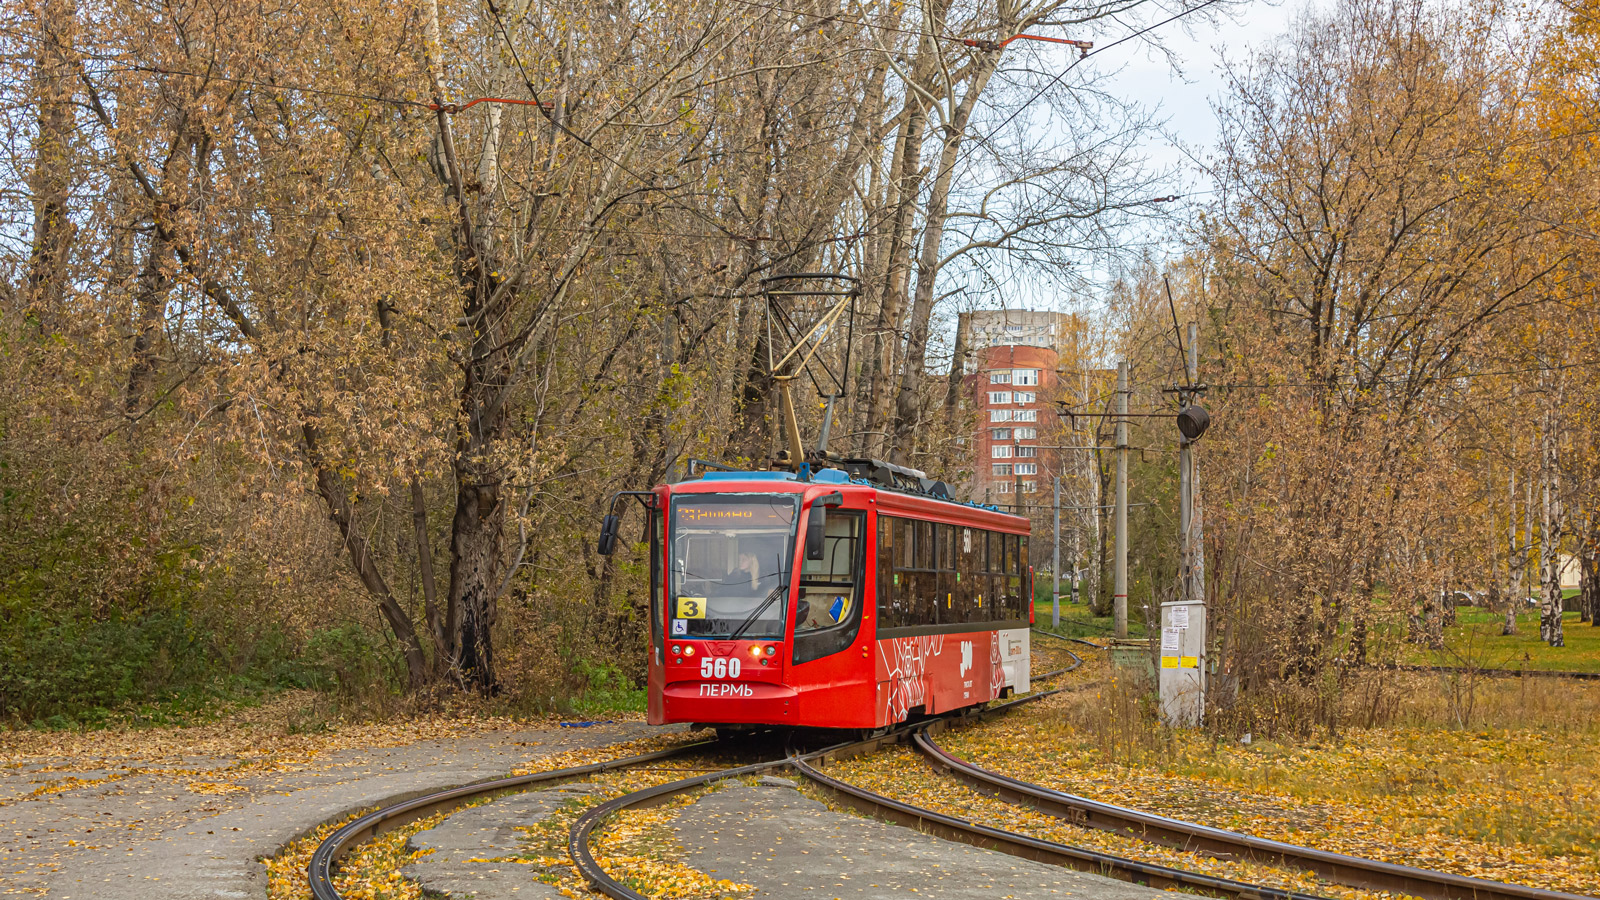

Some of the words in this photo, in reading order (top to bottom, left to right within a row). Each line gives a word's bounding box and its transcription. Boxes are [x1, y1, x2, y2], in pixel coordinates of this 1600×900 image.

[683, 601, 699, 617] 3
[700, 657, 741, 679] 560
[700, 684, 753, 697] ПЕРМЬ
